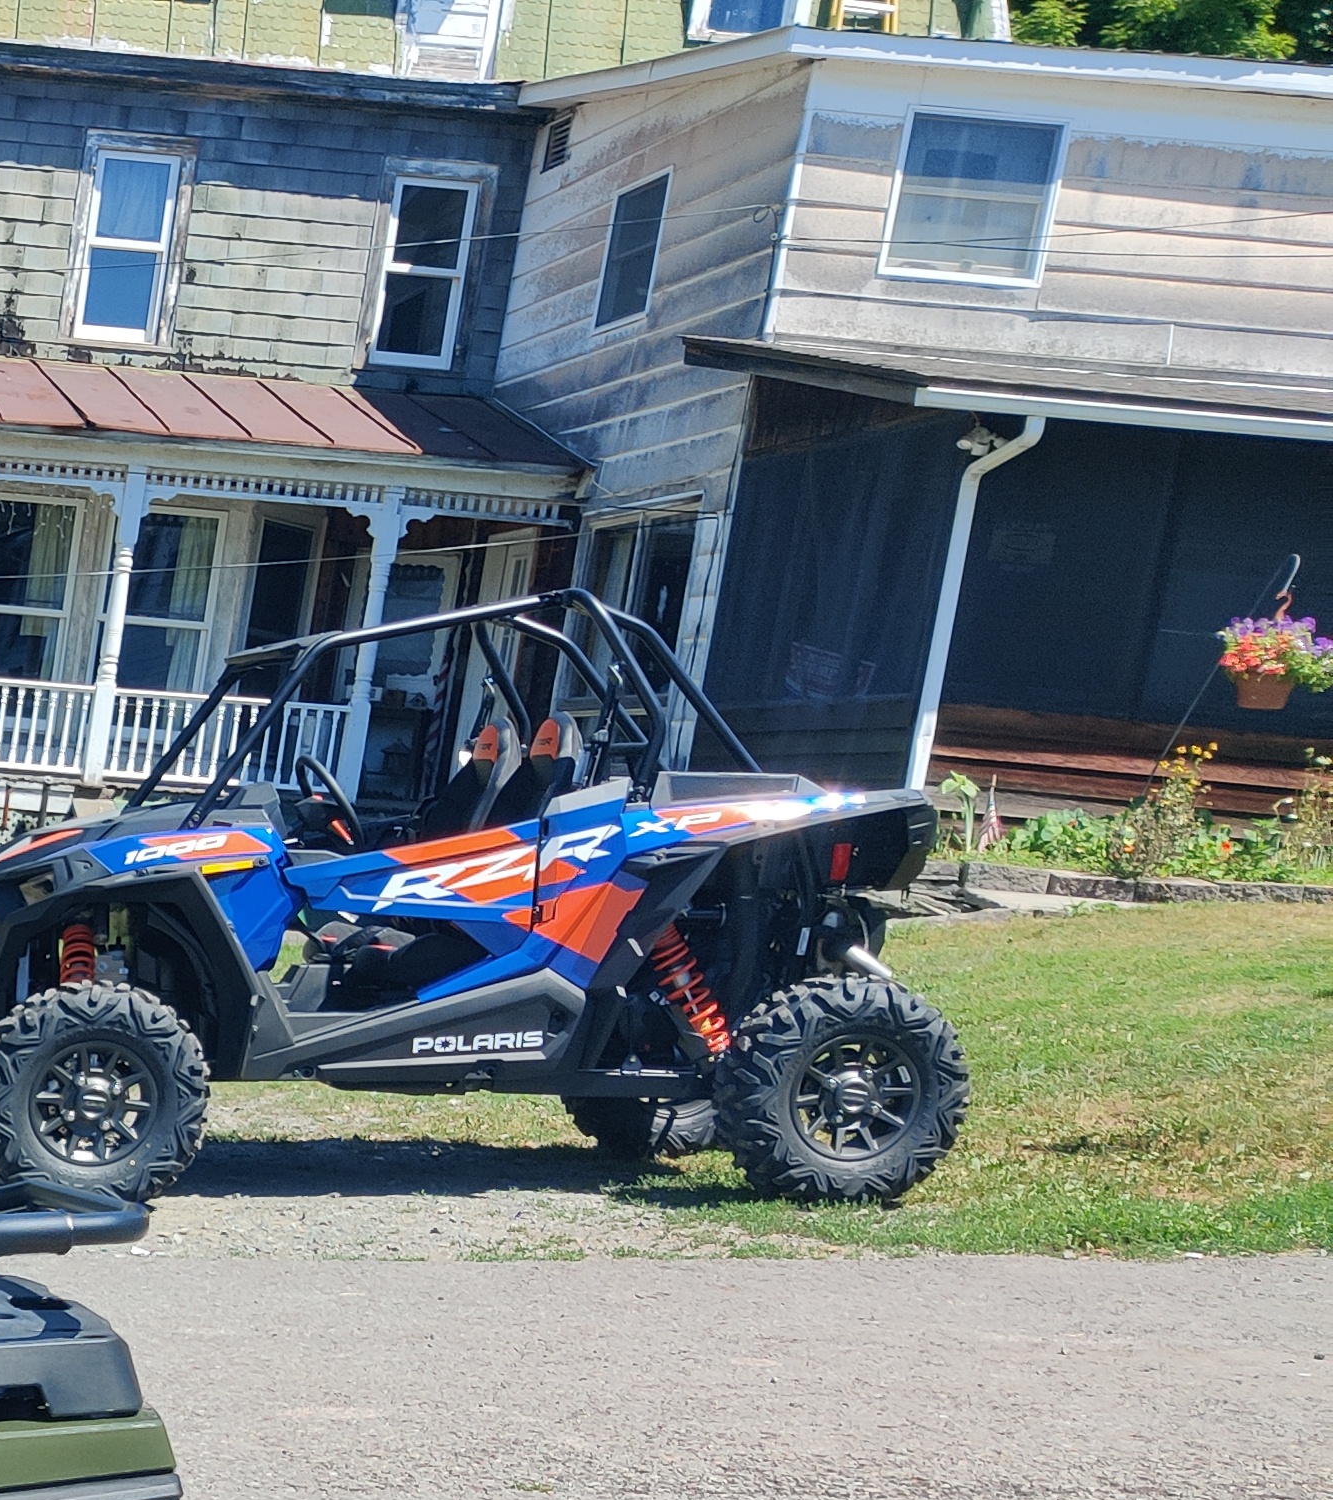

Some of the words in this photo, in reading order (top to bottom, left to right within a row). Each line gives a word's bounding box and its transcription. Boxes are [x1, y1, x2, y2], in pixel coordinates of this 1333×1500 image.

[629, 812, 721, 837] XP
[124, 834, 227, 864] 1000
[372, 823, 621, 911] RZR
[412, 1031, 544, 1055] POLARIS
